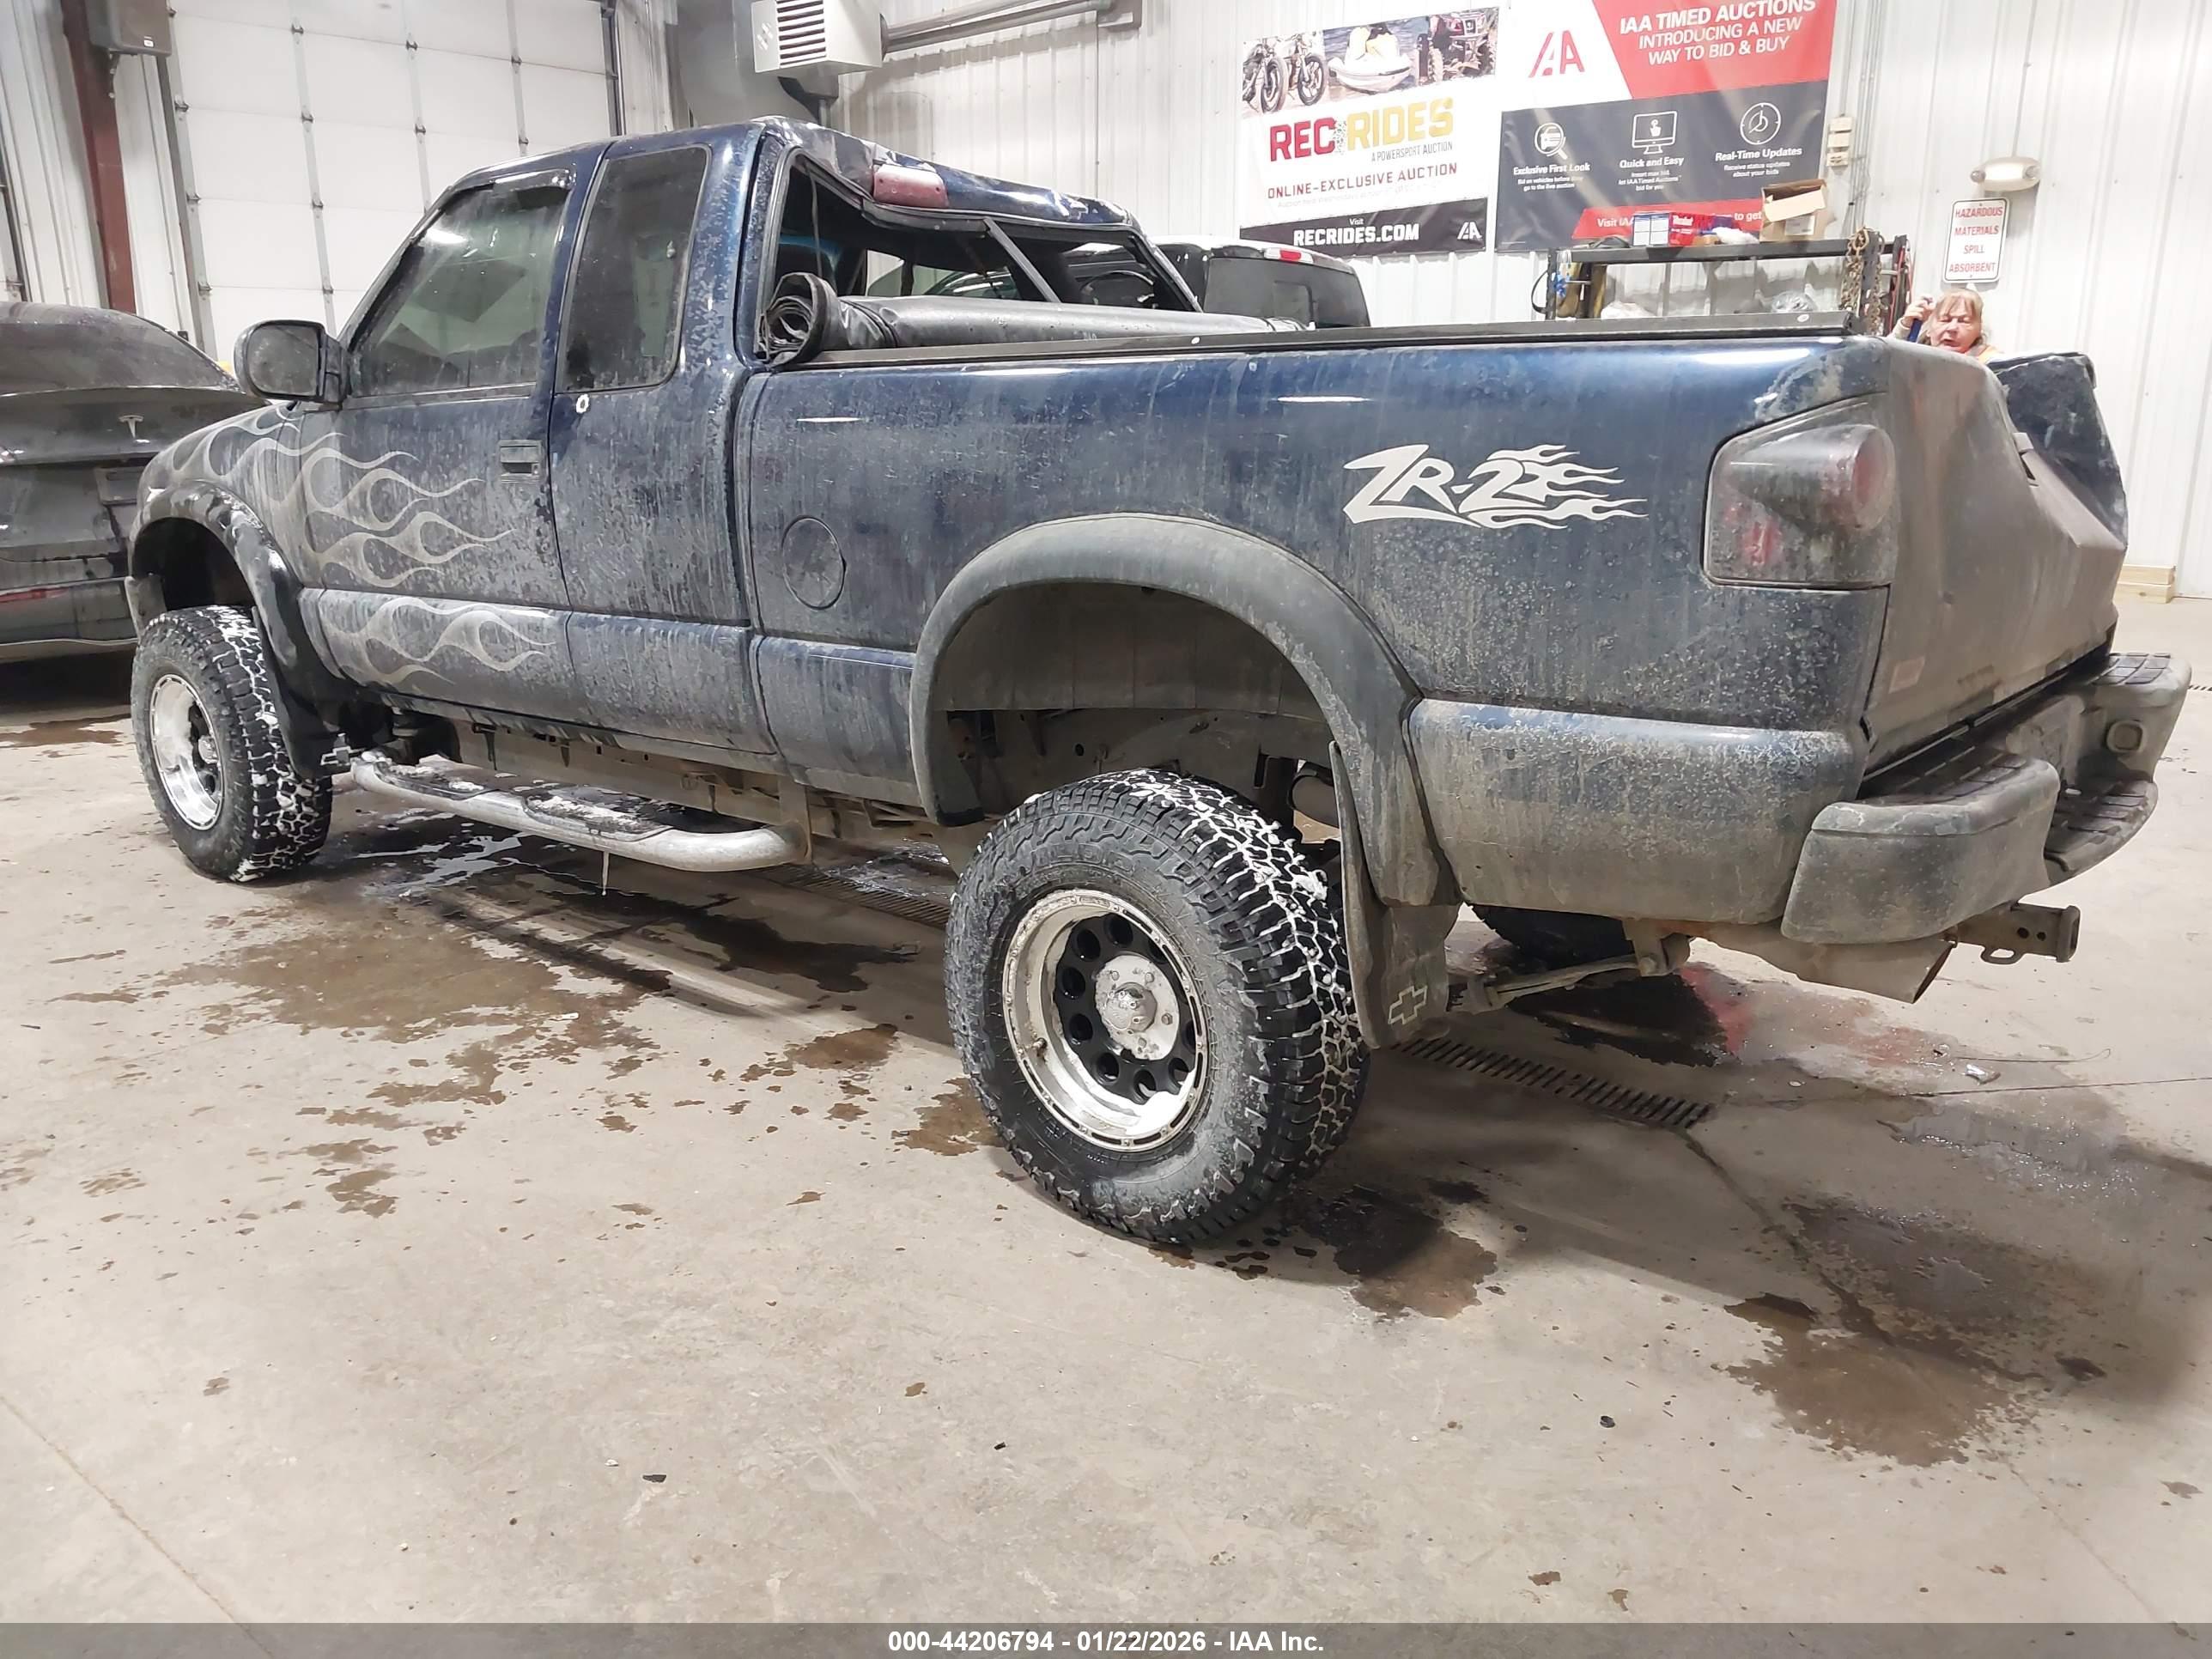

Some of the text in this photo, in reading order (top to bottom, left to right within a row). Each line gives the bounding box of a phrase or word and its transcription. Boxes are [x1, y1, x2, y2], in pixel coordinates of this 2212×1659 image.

[1620, 0, 1815, 34] IAA TIMED AUCTIONS
[1638, 16, 1803, 49] INTRODUCING A NEW
[1648, 36, 1790, 65] WAY TO BID & BUY
[1269, 97, 1454, 162] REC RIDES
[1376, 145, 1420, 162] POWERSPORT
[1422, 142, 1453, 155] AUCTION
[1716, 147, 1802, 161] Real-Time Updates
[1513, 162, 1590, 175] Exclusive First Look
[1620, 156, 1684, 168] Quick and Easy
[1267, 172, 1393, 199] ONLINE-EXCLUSIVE
[1397, 162, 1457, 181] AUCTION
[1745, 212, 1762, 222] get
[1955, 207, 2003, 217] HAZARDOUS
[1597, 218, 1618, 228] Visit
[1293, 222, 1419, 247] RECRIDES.COM
[1954, 226, 1999, 236] MATERIALS
[1963, 245, 1984, 254] SPILL
[1949, 263, 1996, 273] ABSORBENT
